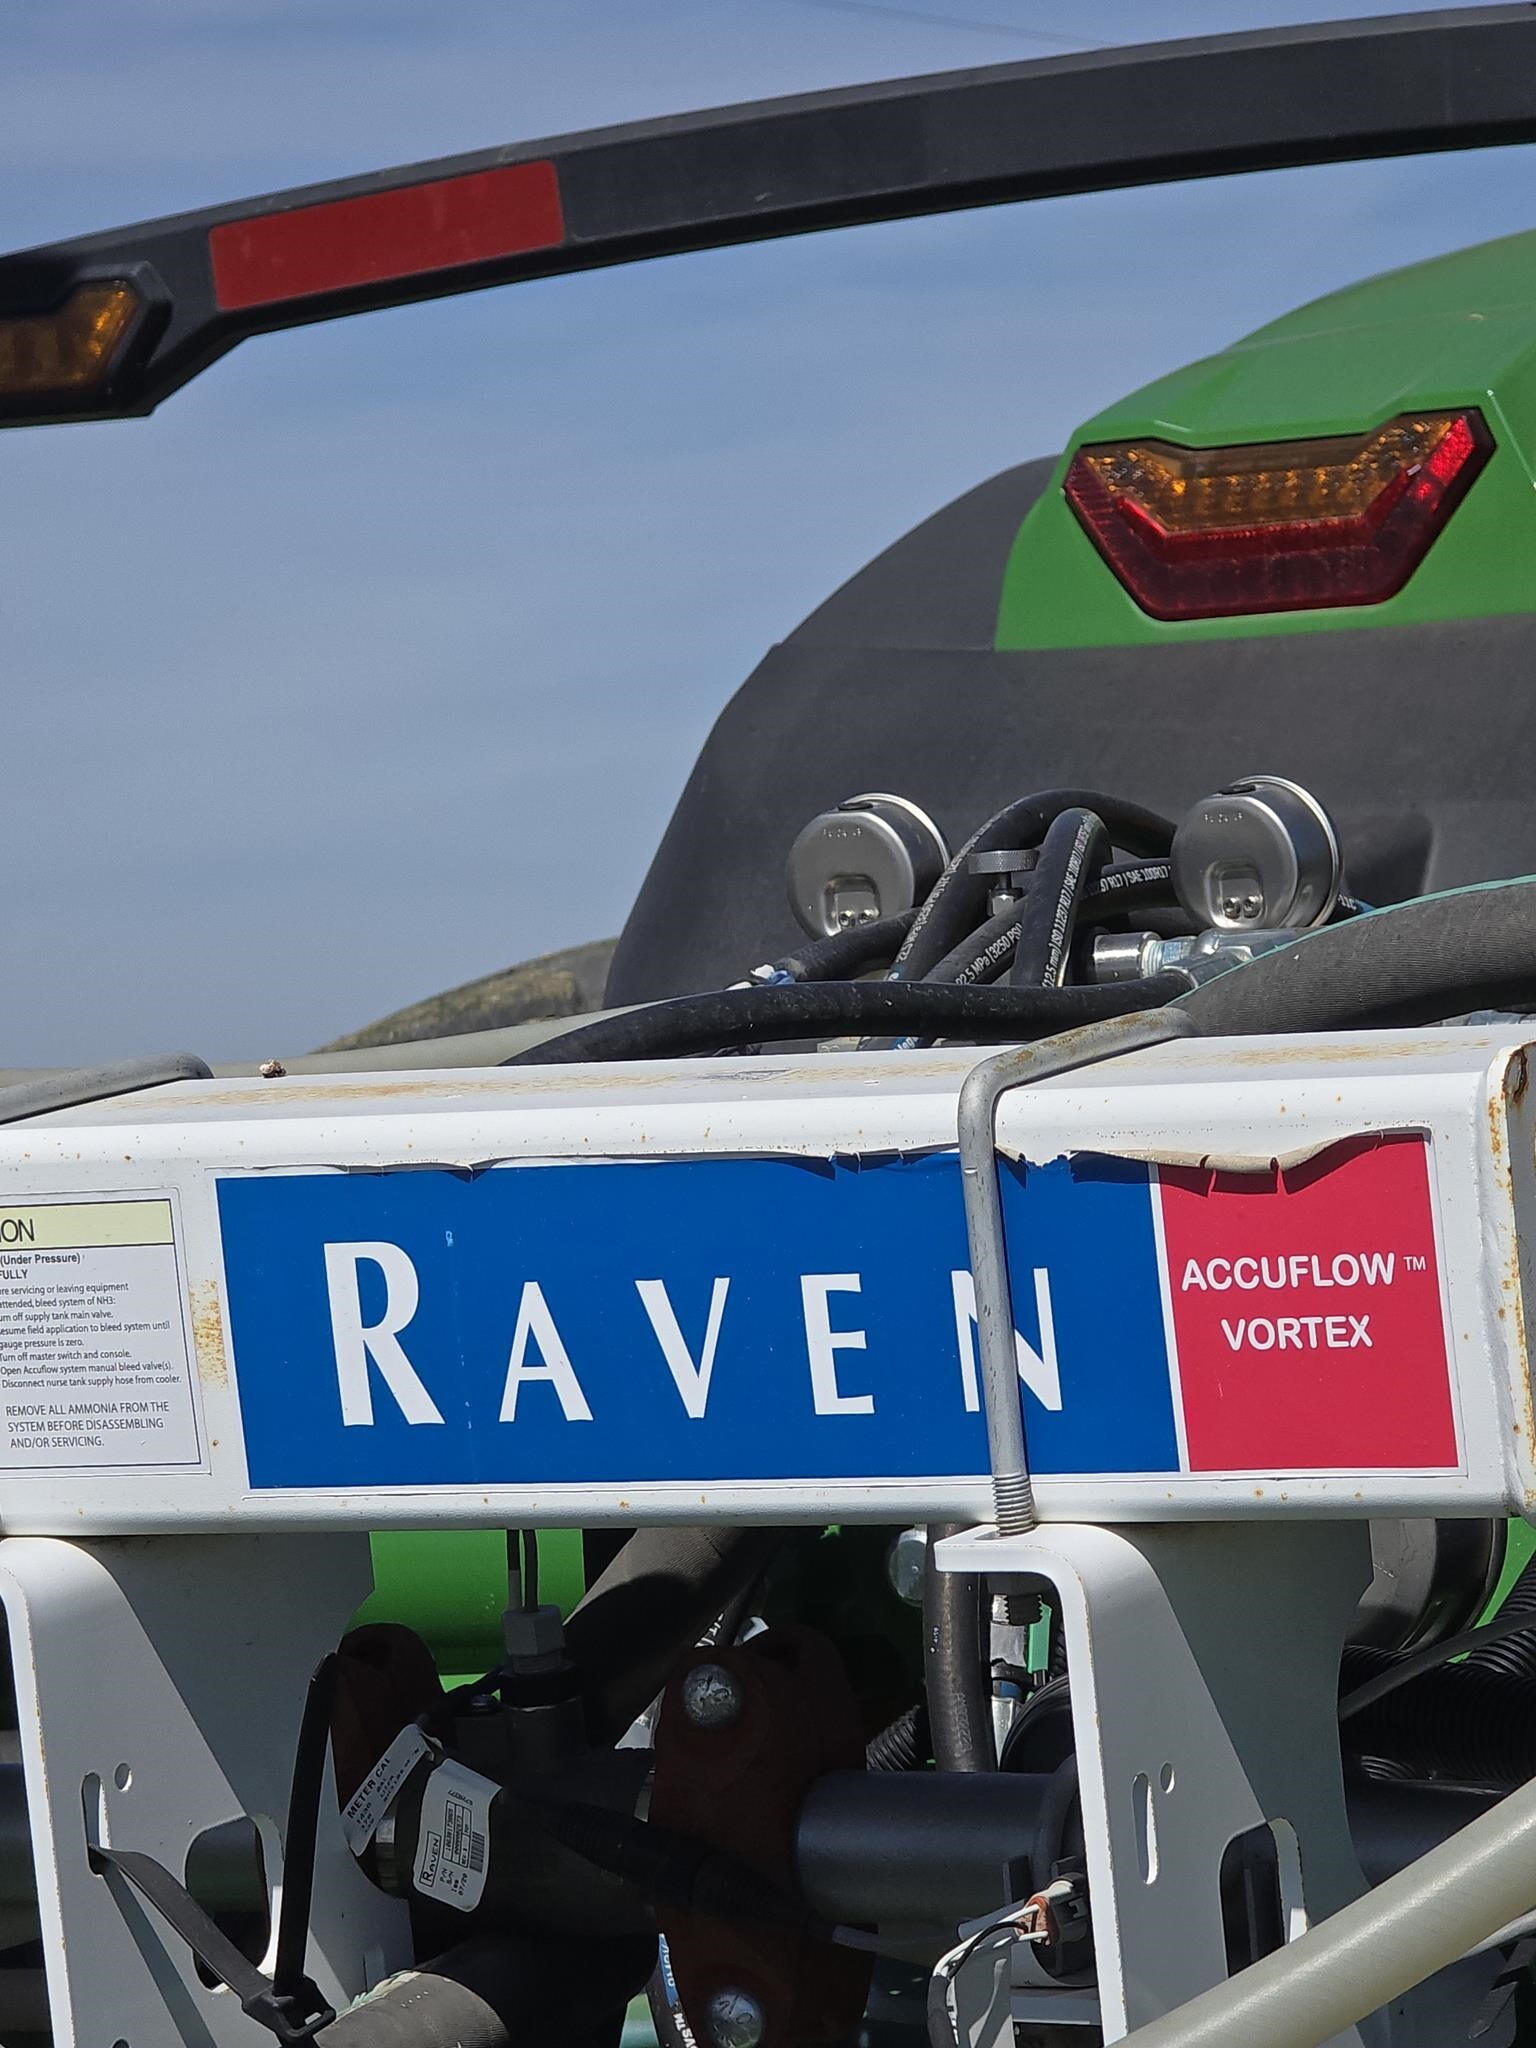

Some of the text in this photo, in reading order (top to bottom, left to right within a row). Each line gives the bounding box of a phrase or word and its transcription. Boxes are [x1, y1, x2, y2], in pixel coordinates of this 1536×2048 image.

[0, 1218, 35, 1243] ON
[0, 1252, 81, 1268] (Under Pressure)
[1181, 1252, 1395, 1291] ACCUFLOW
[11, 1284, 45, 1296] servicing
[56, 1283, 85, 1294] leaving
[86, 1282, 129, 1293] equipment
[35, 1298, 57, 1308] bleed
[58, 1299, 86, 1309] system
[87, 1297, 95, 1305] of
[96, 1296, 116, 1306] NH3:
[13, 1312, 23, 1321] off
[24, 1311, 50, 1323] supply
[52, 1309, 69, 1320] tank
[70, 1310, 90, 1319] main
[91, 1309, 114, 1319] valve.
[27, 1325, 45, 1335] field
[45, 1324, 89, 1336] application
[90, 1324, 99, 1332] to
[100, 1322, 122, 1332] bleed
[123, 1323, 151, 1333] system
[152, 1321, 170, 1330] until
[324, 1240, 1063, 1427] RAVEN
[1220, 1314, 1373, 1351] VORTEX
[0, 1339, 84, 1351] gauge pressure is zero.
[17, 1351, 28, 1361] off
[29, 1352, 56, 1361] master
[57, 1350, 83, 1360] switch
[84, 1350, 99, 1359] and
[100, 1349, 132, 1359] console.
[0, 1366, 22, 1376] Open
[23, 1364, 58, 1375] Accuflow
[59, 1365, 87, 1375] system
[88, 1363, 117, 1373] manual
[119, 1361, 141, 1372] bleed
[1, 1374, 182, 1389] Disconnect nurse tank supply hose from cooler.
[5, 1401, 170, 1417] REMOVE ALL AMMONIA FROM THE
[7, 1418, 164, 1433] SYSTEM BEFORE DISASSEMBLING
[10, 1436, 104, 1449] AND/OR SERVICING.
[346, 1779, 376, 1820] METER
[422, 1837, 440, 1883] RAVEN
[439, 1867, 448, 1883] P/N
